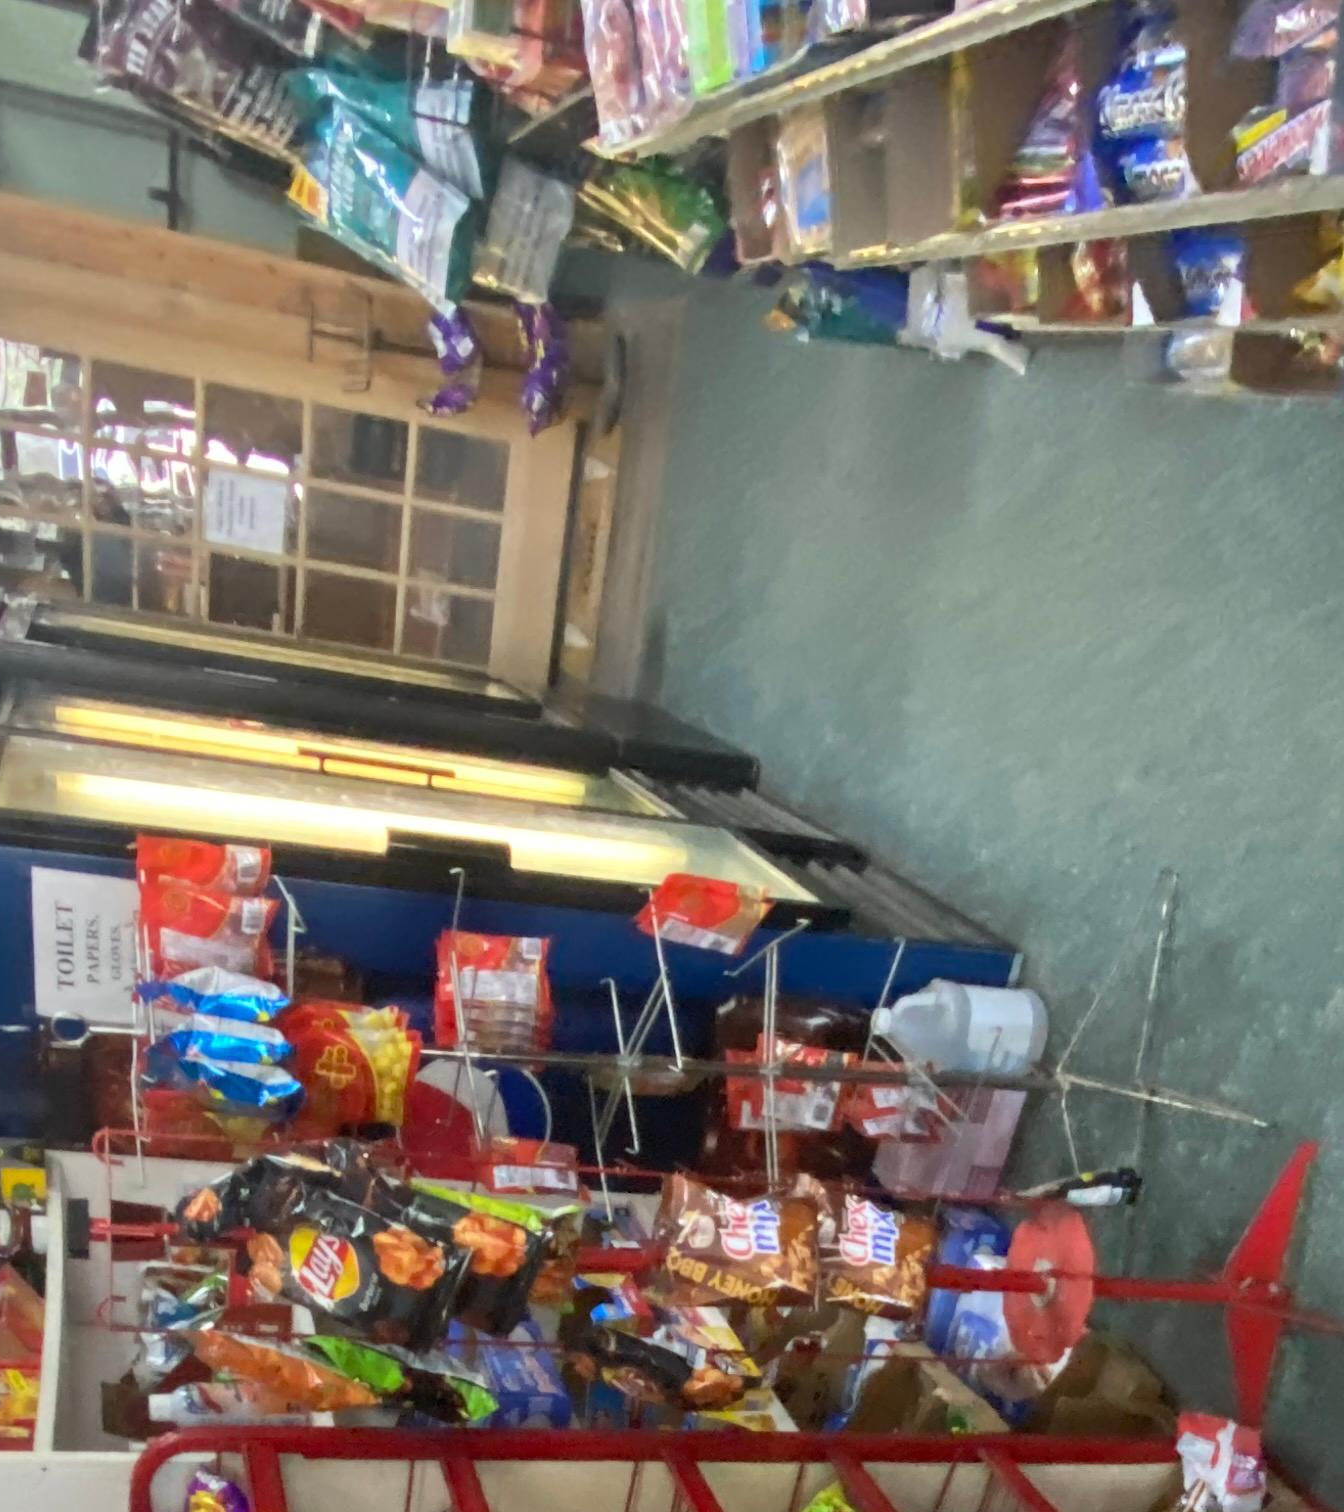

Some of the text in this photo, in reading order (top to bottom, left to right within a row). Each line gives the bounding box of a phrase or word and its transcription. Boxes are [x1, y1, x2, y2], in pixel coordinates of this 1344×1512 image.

[54, 901, 75, 991] TOILET
[718, 1194, 754, 1260] Chex
[838, 1193, 869, 1266] Chex
[666, 1246, 708, 1283] BBQ
